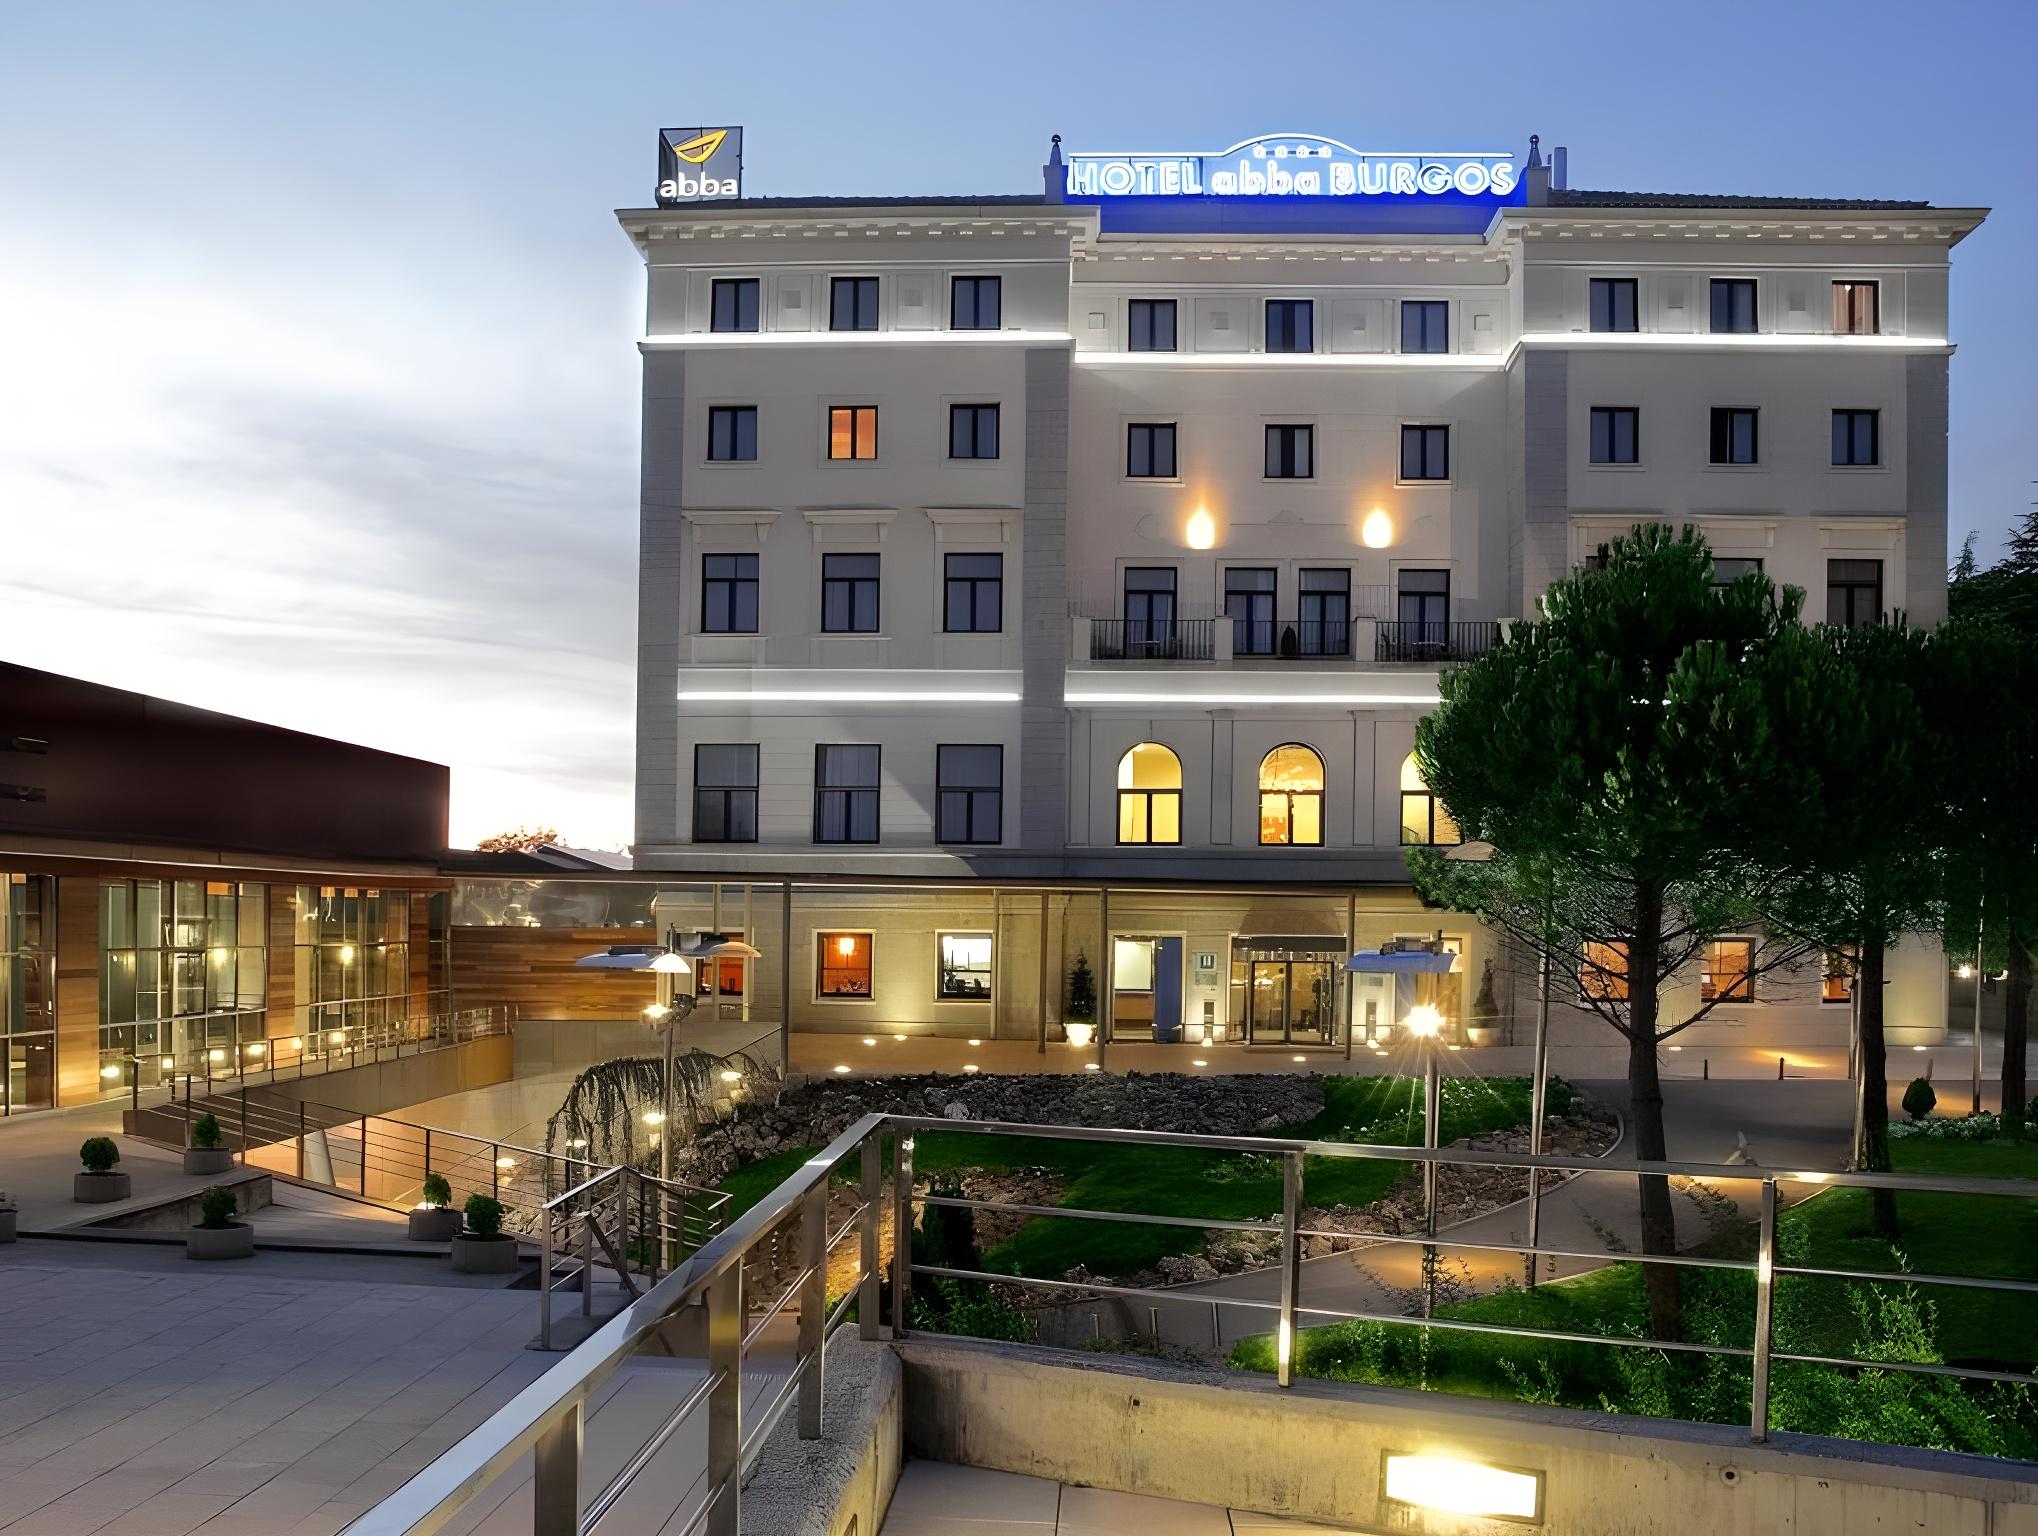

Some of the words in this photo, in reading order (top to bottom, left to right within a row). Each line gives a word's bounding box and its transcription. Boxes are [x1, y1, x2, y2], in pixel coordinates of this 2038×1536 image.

[660, 171, 738, 198] abba
[1067, 161, 1203, 195] HOTEL
[1211, 159, 1320, 195] abba
[1329, 162, 1517, 196] BURGOS
